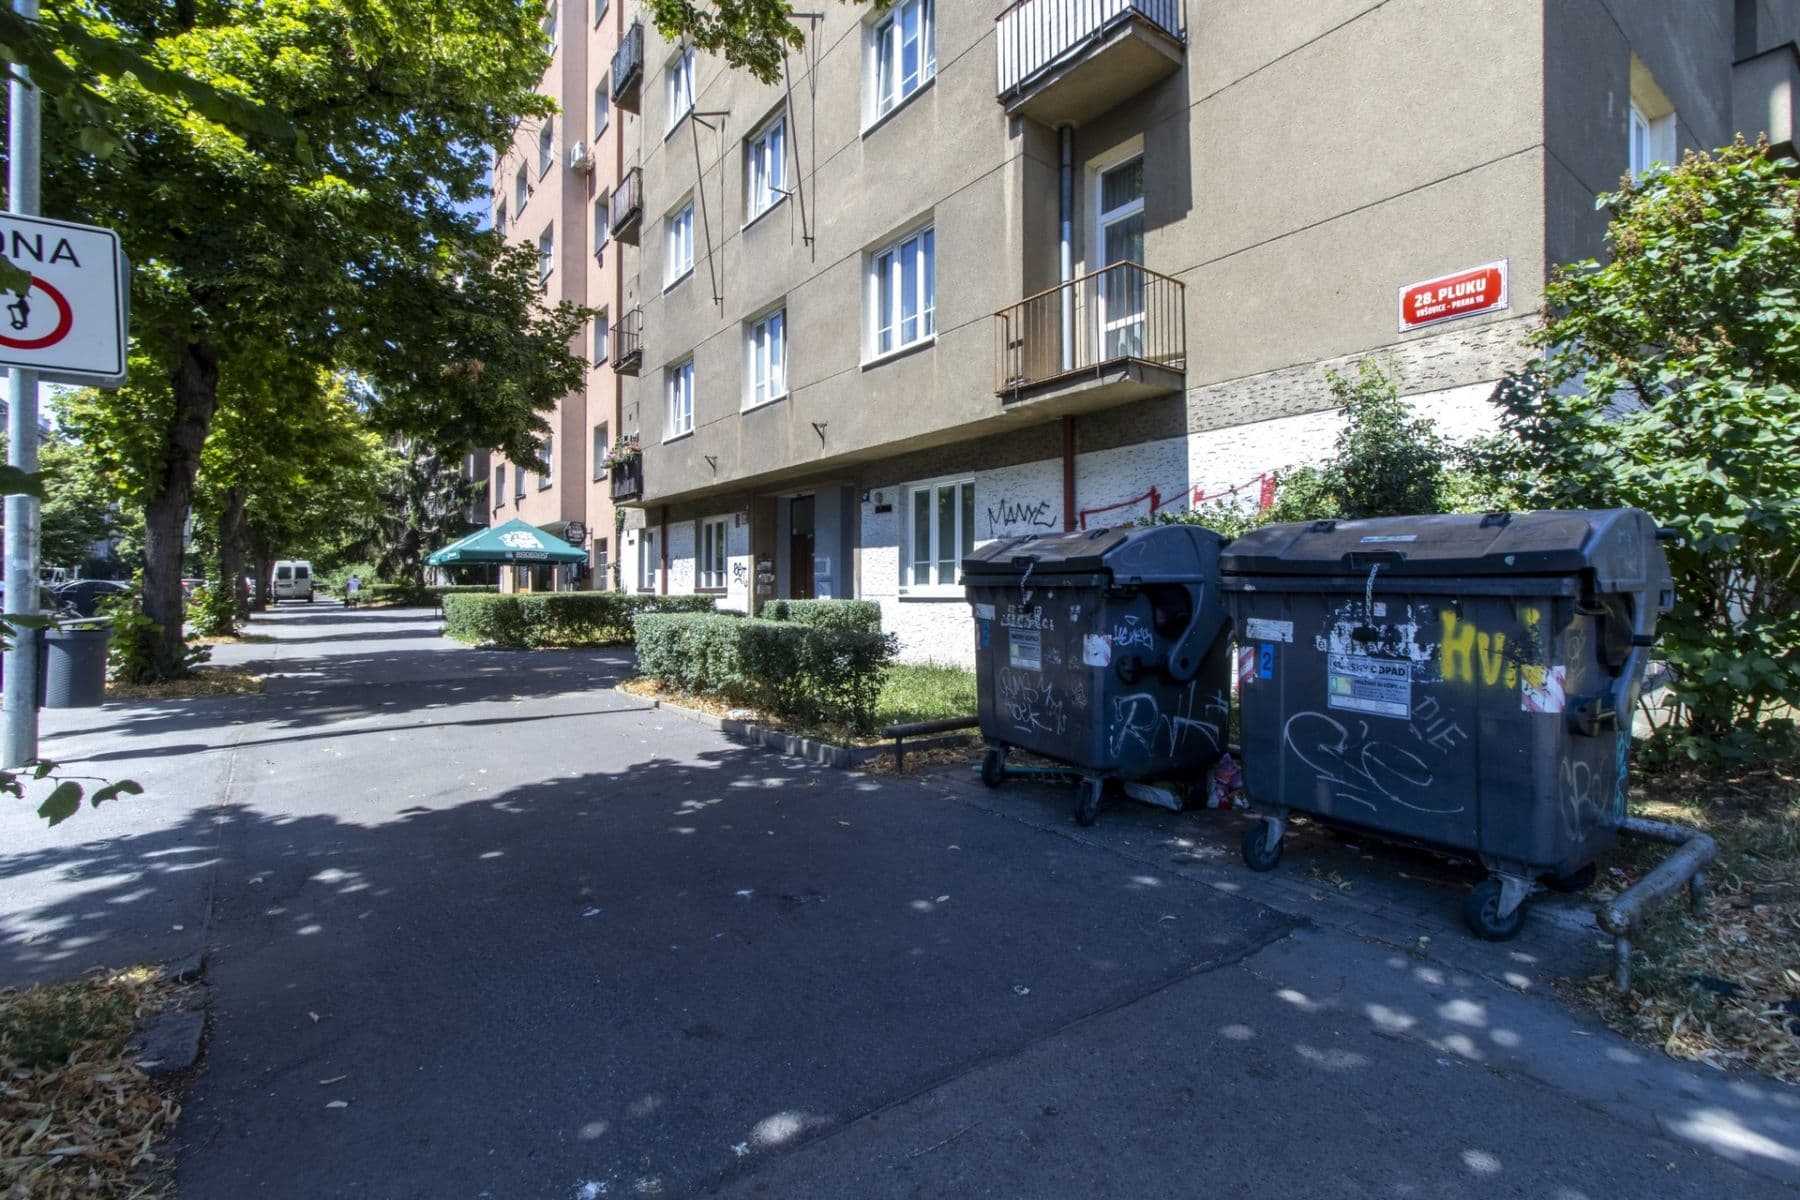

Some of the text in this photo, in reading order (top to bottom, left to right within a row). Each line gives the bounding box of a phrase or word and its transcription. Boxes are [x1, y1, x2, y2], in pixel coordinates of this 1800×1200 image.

[0, 229, 81, 268] NA
[1414, 277, 1487, 308] 28. PLUKU
[1452, 296, 1475, 309] PRAHA
[1263, 651, 1272, 671] 2
